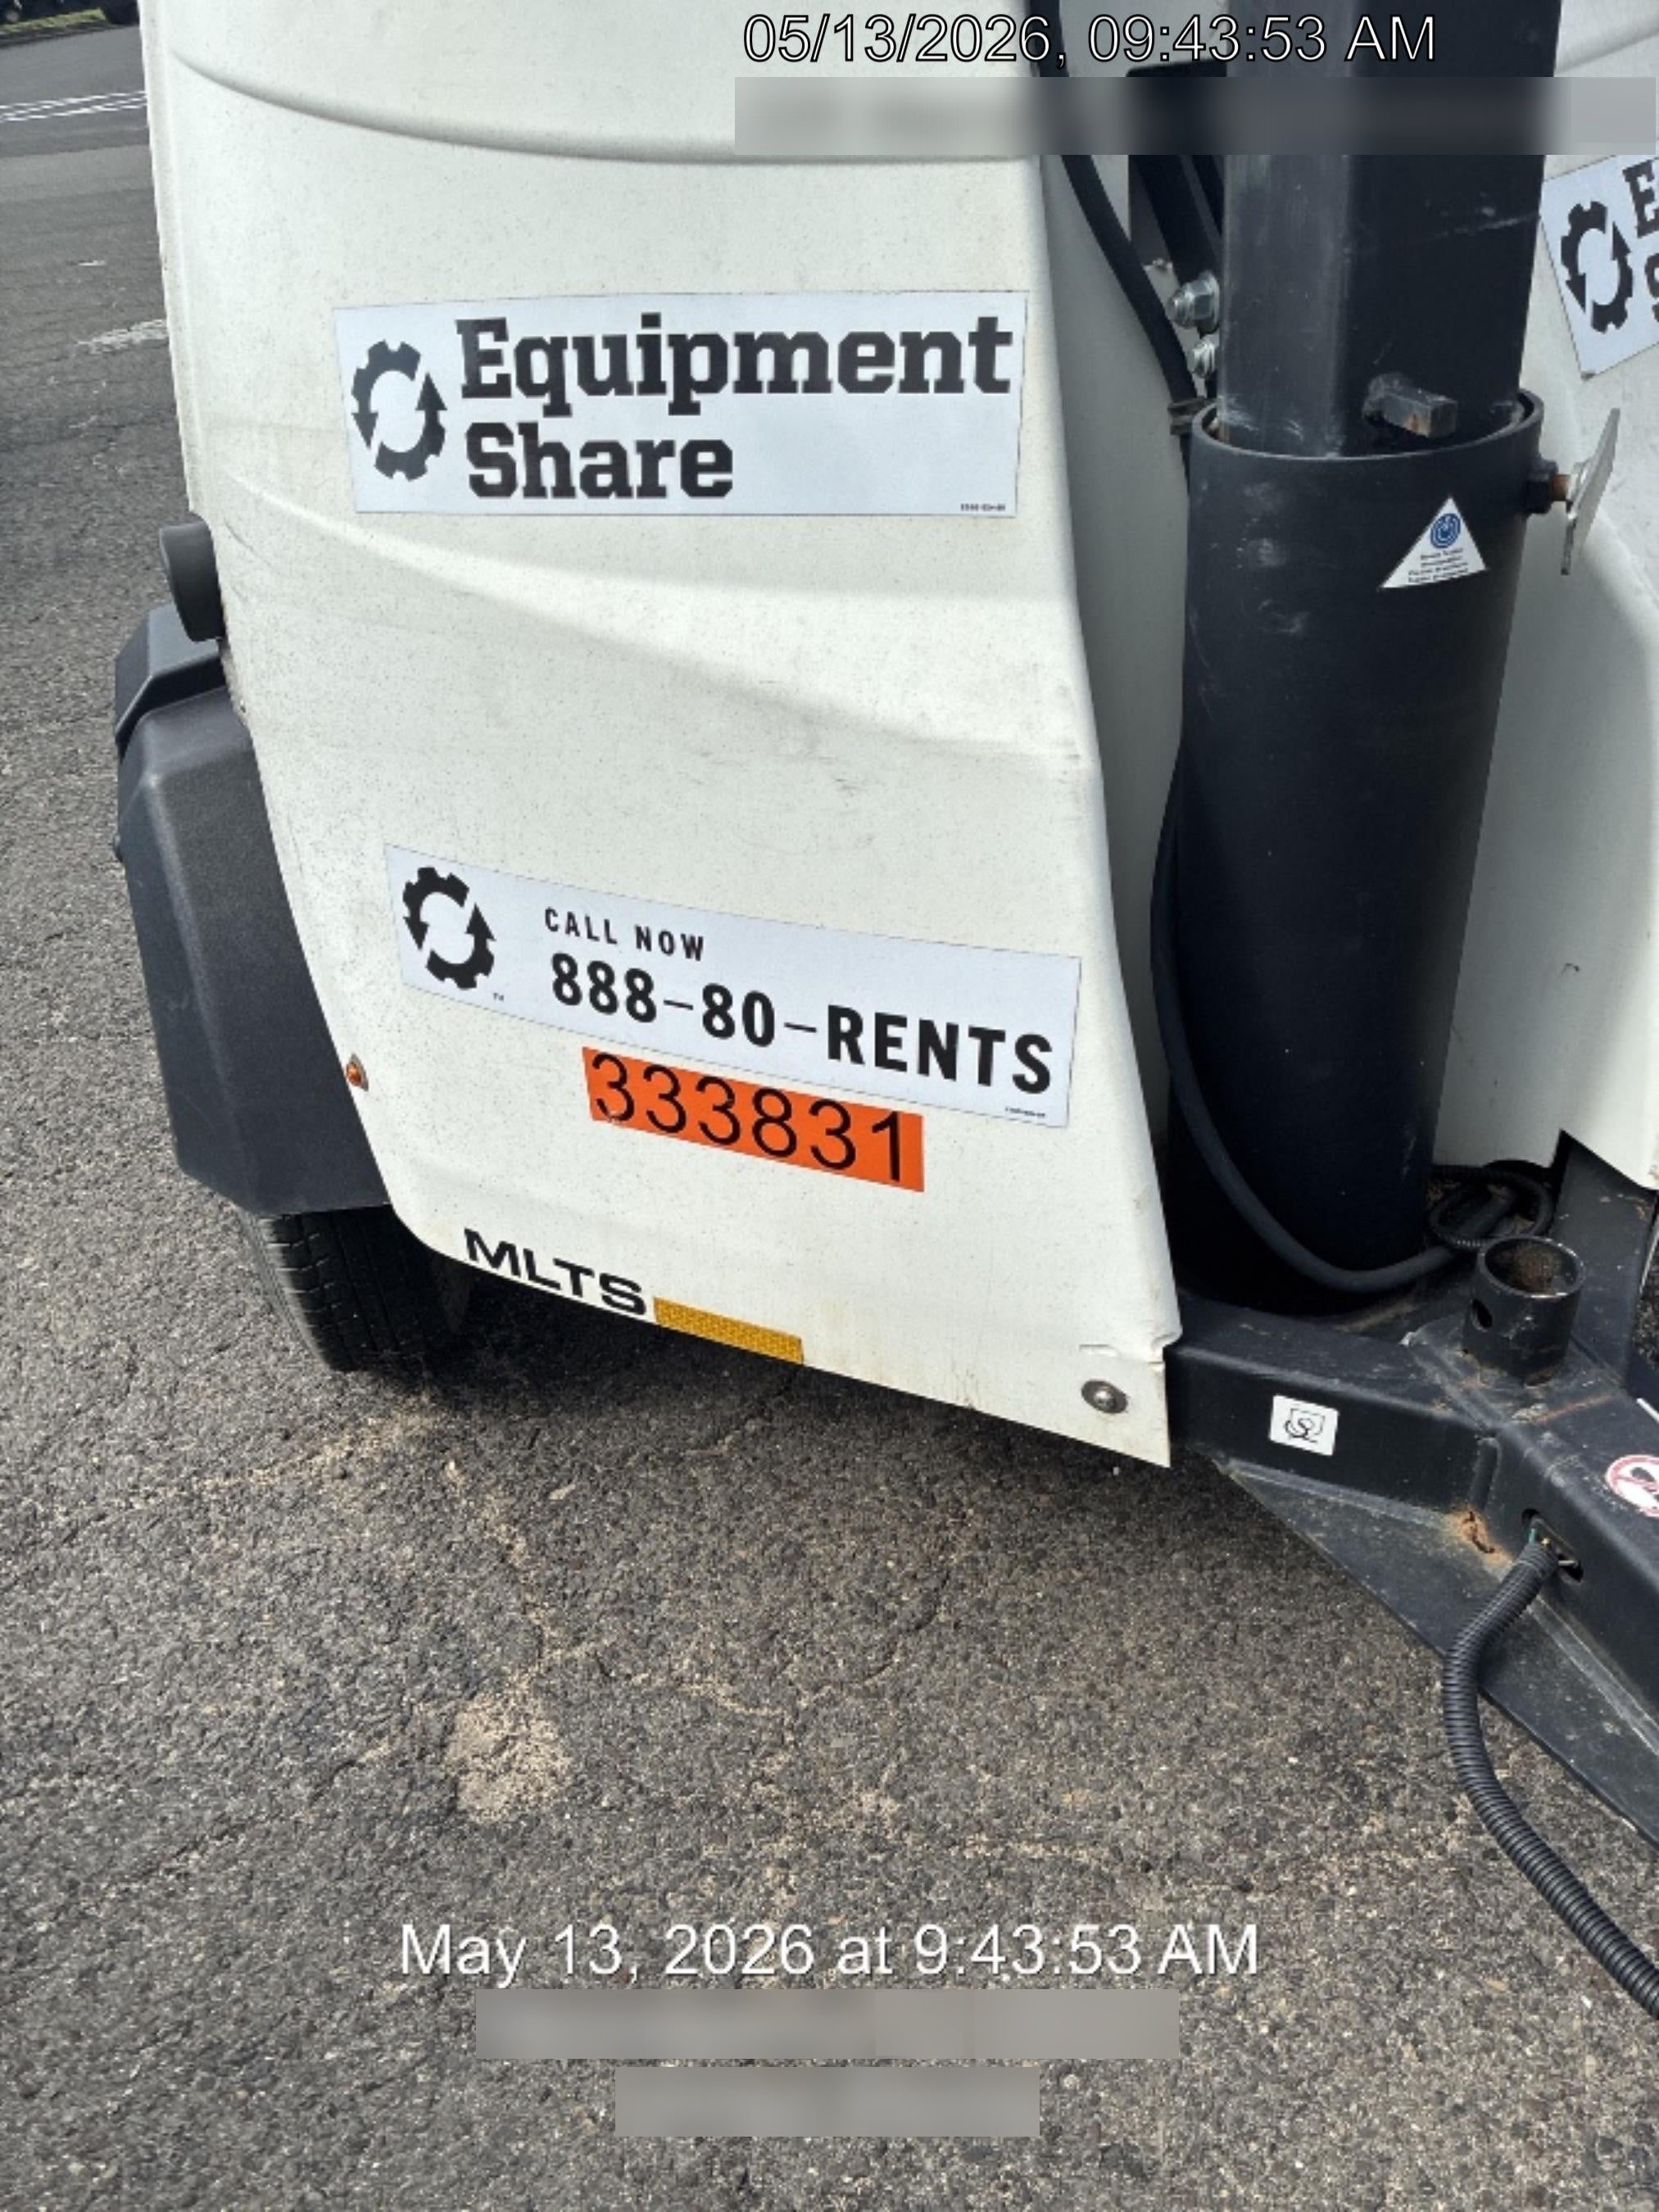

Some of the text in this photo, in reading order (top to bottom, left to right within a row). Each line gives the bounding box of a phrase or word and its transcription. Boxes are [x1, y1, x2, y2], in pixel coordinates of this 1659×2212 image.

[456, 312, 1013, 418] Equipment
[465, 421, 733, 499] Share
[545, 907, 705, 962] CALL NOW
[551, 952, 1053, 1095] 888-80-RENTS
[592, 1053, 902, 1181] 333831
[464, 1228, 646, 1316] MLTS
